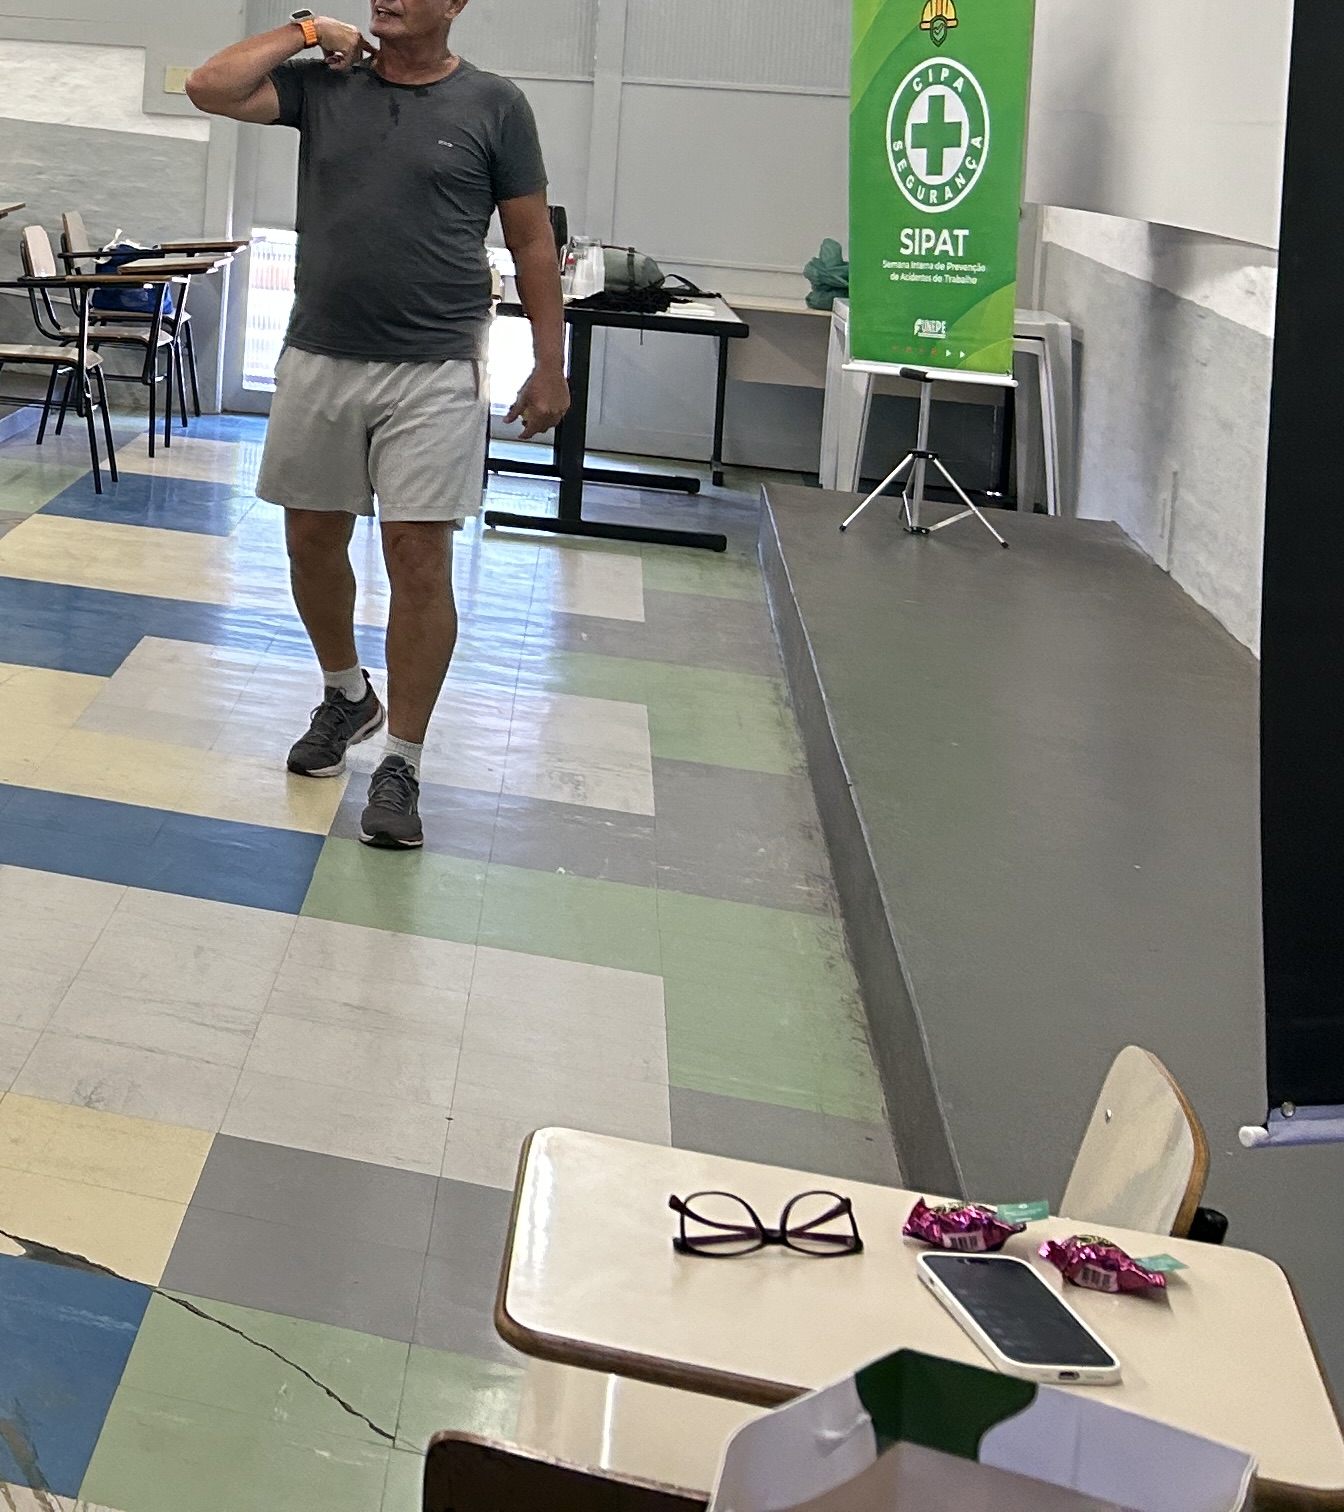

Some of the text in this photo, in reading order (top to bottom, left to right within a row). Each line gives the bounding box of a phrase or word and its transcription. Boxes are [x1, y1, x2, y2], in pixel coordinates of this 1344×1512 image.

[912, 67, 965, 93] CIPA
[892, 136, 983, 204] SEGURANÇA
[899, 227, 970, 257] SIPAT
[882, 259, 910, 269] Semana
[934, 262, 945, 271] de
[946, 261, 986, 274] Prevenção
[889, 272, 899, 281] de
[932, 274, 943, 283] de
[944, 273, 978, 285] Trabalho
